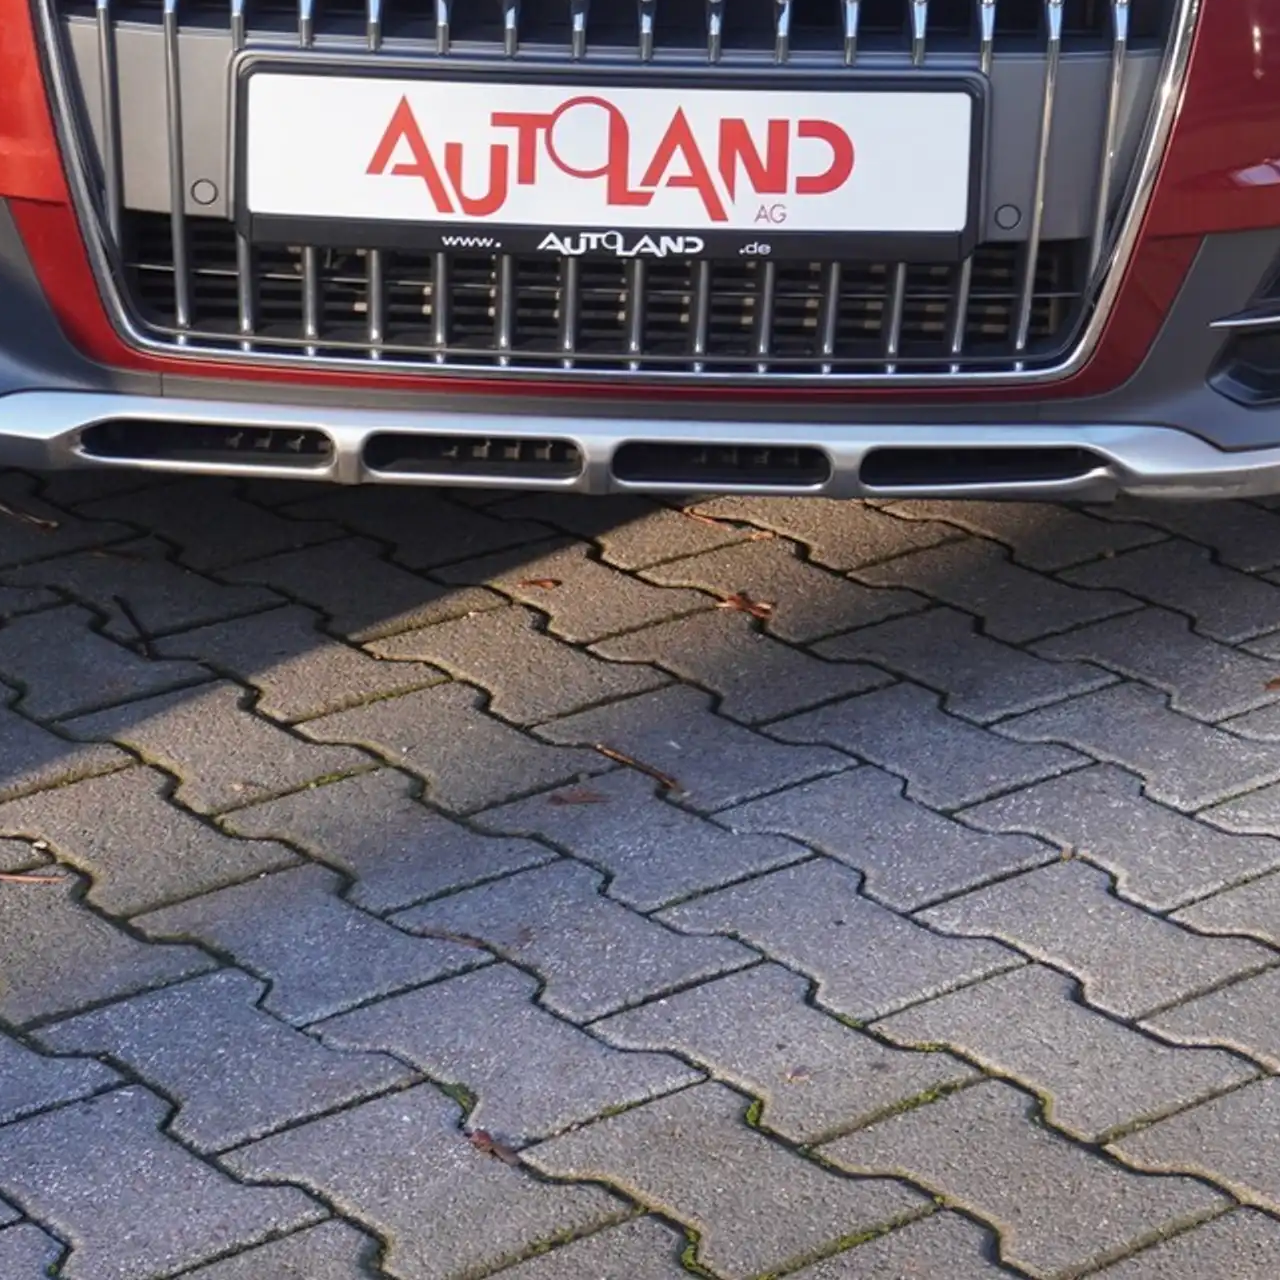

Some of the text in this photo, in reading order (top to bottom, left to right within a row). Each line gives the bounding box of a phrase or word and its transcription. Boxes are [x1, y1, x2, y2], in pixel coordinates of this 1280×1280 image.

[364, 94, 855, 221] AUTOLAND
[754, 204, 787, 223] AG
[441, 230, 771, 258] www. AUTOLAND .de
